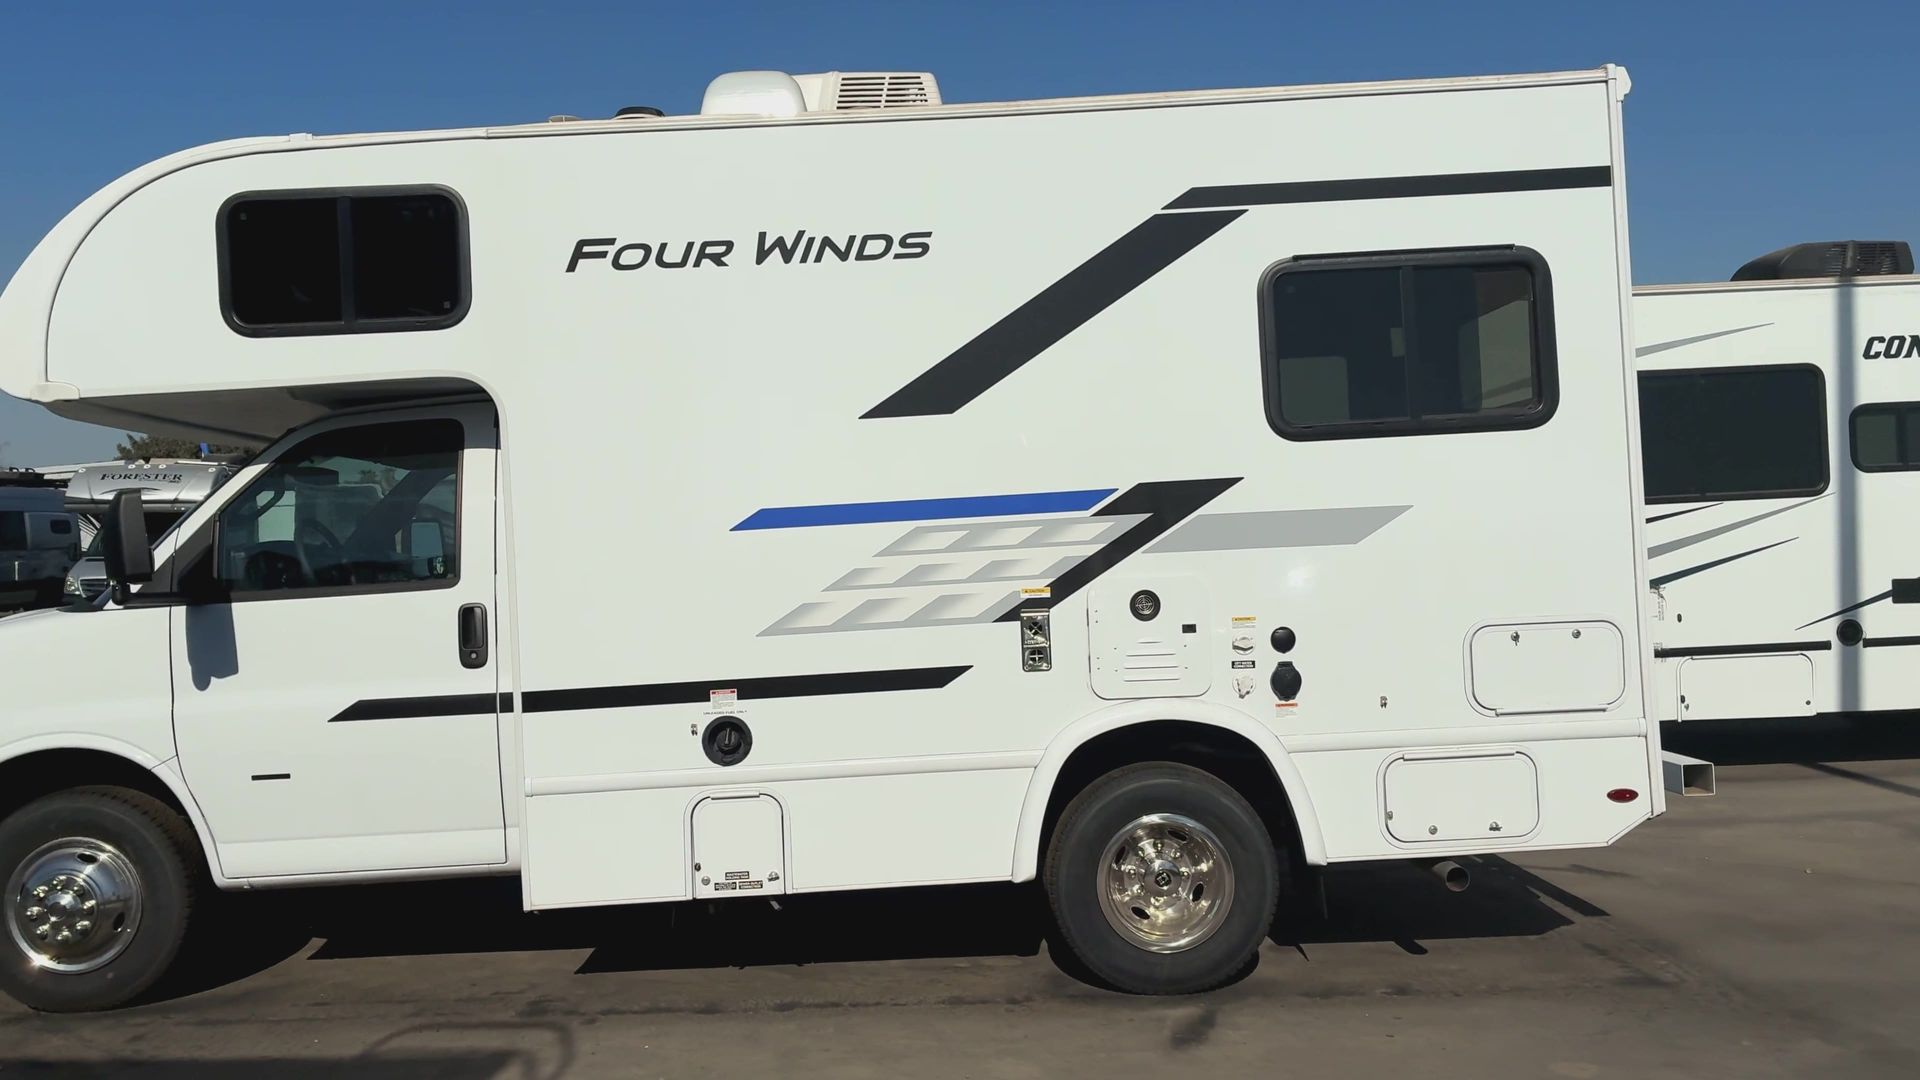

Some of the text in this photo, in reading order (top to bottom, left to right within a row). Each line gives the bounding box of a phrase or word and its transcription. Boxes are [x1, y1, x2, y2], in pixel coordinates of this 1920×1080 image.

[565, 230, 933, 273] FOUR WINDS
[100, 473, 182, 481] FORESTER
